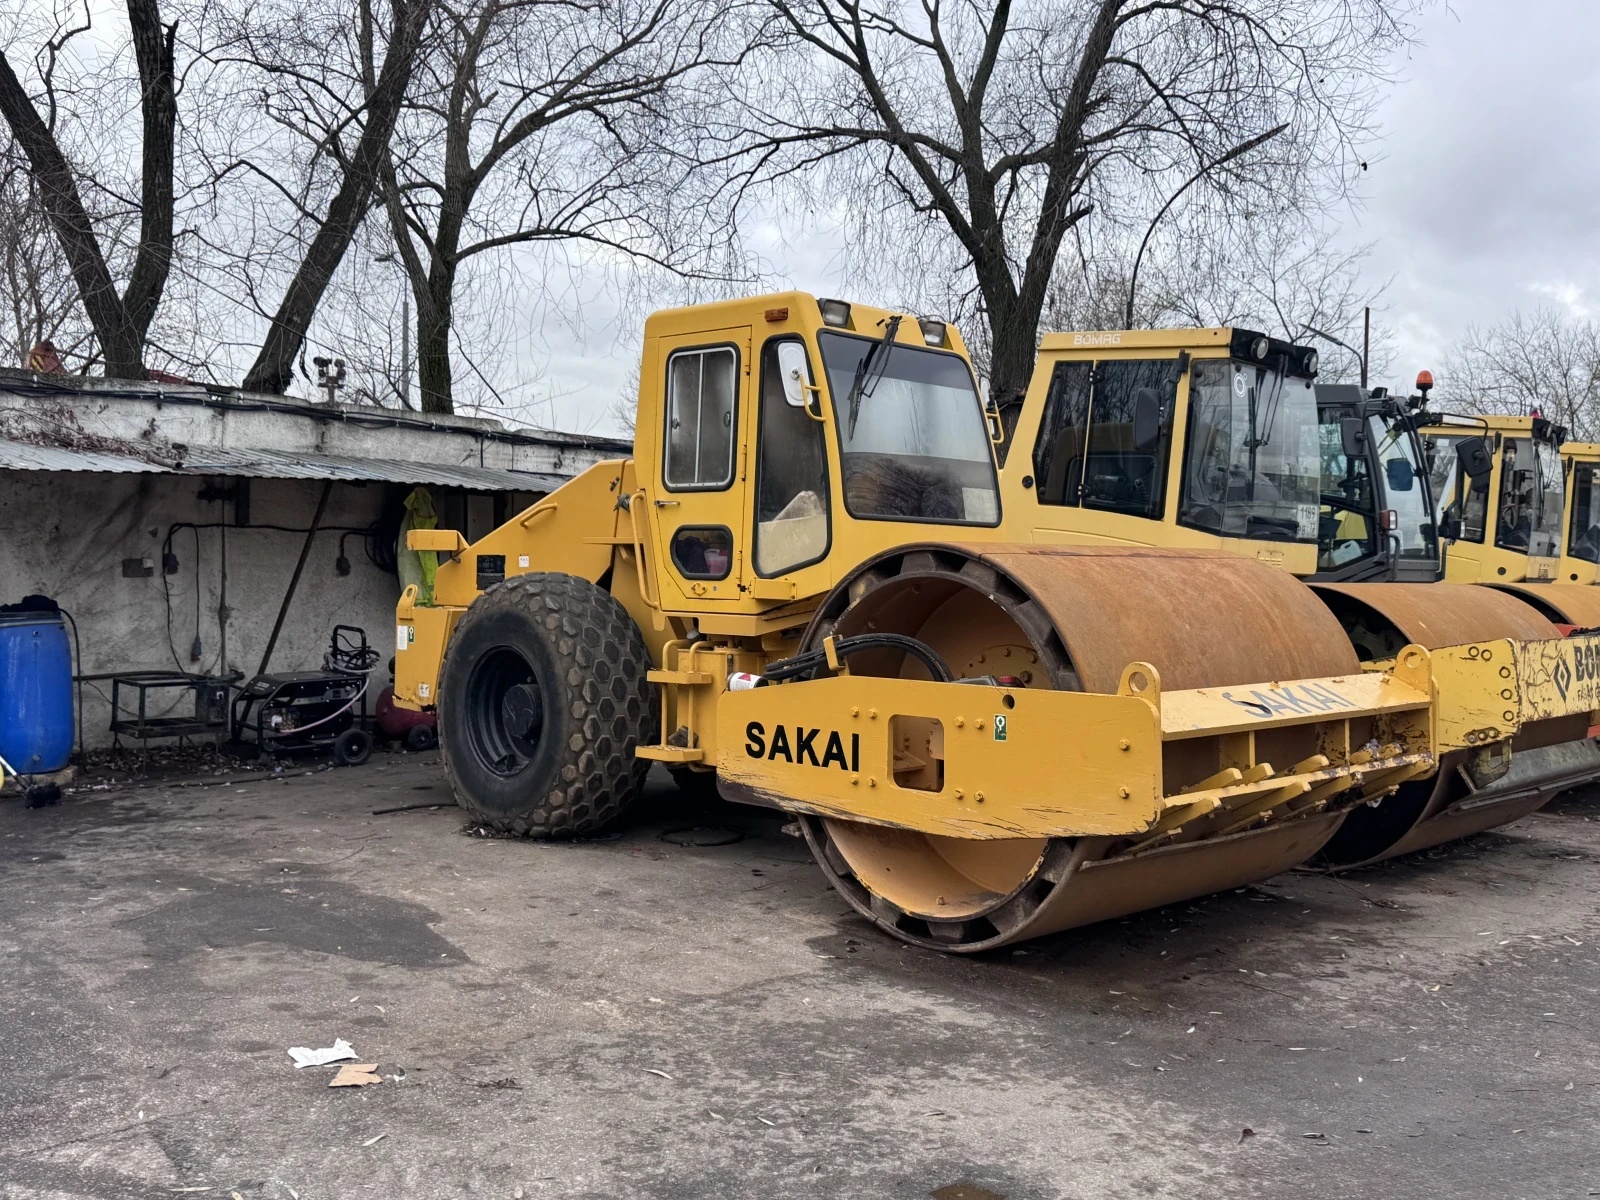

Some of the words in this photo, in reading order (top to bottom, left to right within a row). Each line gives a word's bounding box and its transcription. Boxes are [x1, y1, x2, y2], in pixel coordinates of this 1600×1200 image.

[1073, 333, 1121, 345] BOMAG
[1300, 506, 1316, 520] 1189
[1222, 682, 1357, 719] SAKAI
[744, 721, 860, 773] SAKAI
